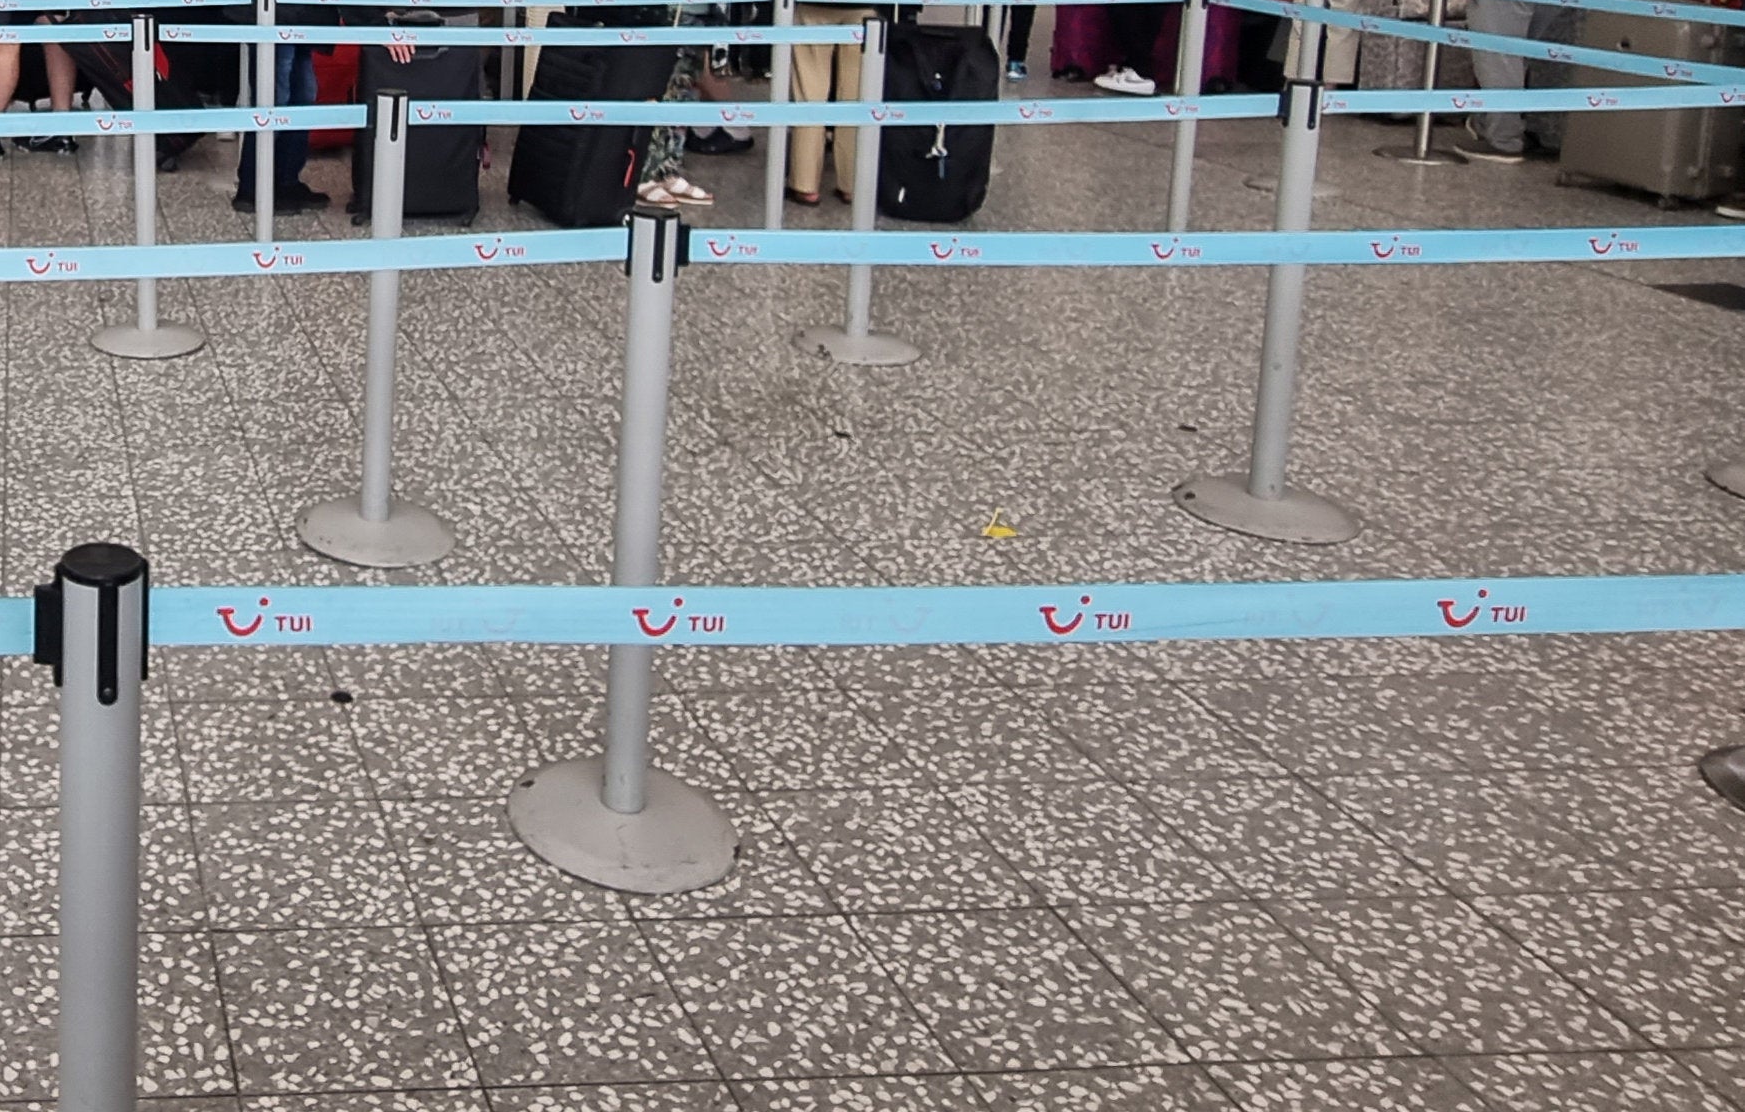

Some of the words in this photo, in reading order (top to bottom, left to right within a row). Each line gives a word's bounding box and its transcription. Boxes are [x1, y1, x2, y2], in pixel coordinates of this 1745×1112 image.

[739, 245, 757, 255] TUI
[1401, 246, 1419, 255] TUI
[1618, 242, 1638, 251] TUI
[505, 248, 523, 256] TUI
[961, 248, 979, 257] TUI
[1182, 248, 1200, 257] TUI
[284, 256, 302, 265] TUI
[58, 263, 76, 271] TUI
[1491, 607, 1525, 622] TUI
[275, 616, 310, 632] TUI
[689, 616, 723, 632] TUI
[1095, 614, 1129, 629] TUI
